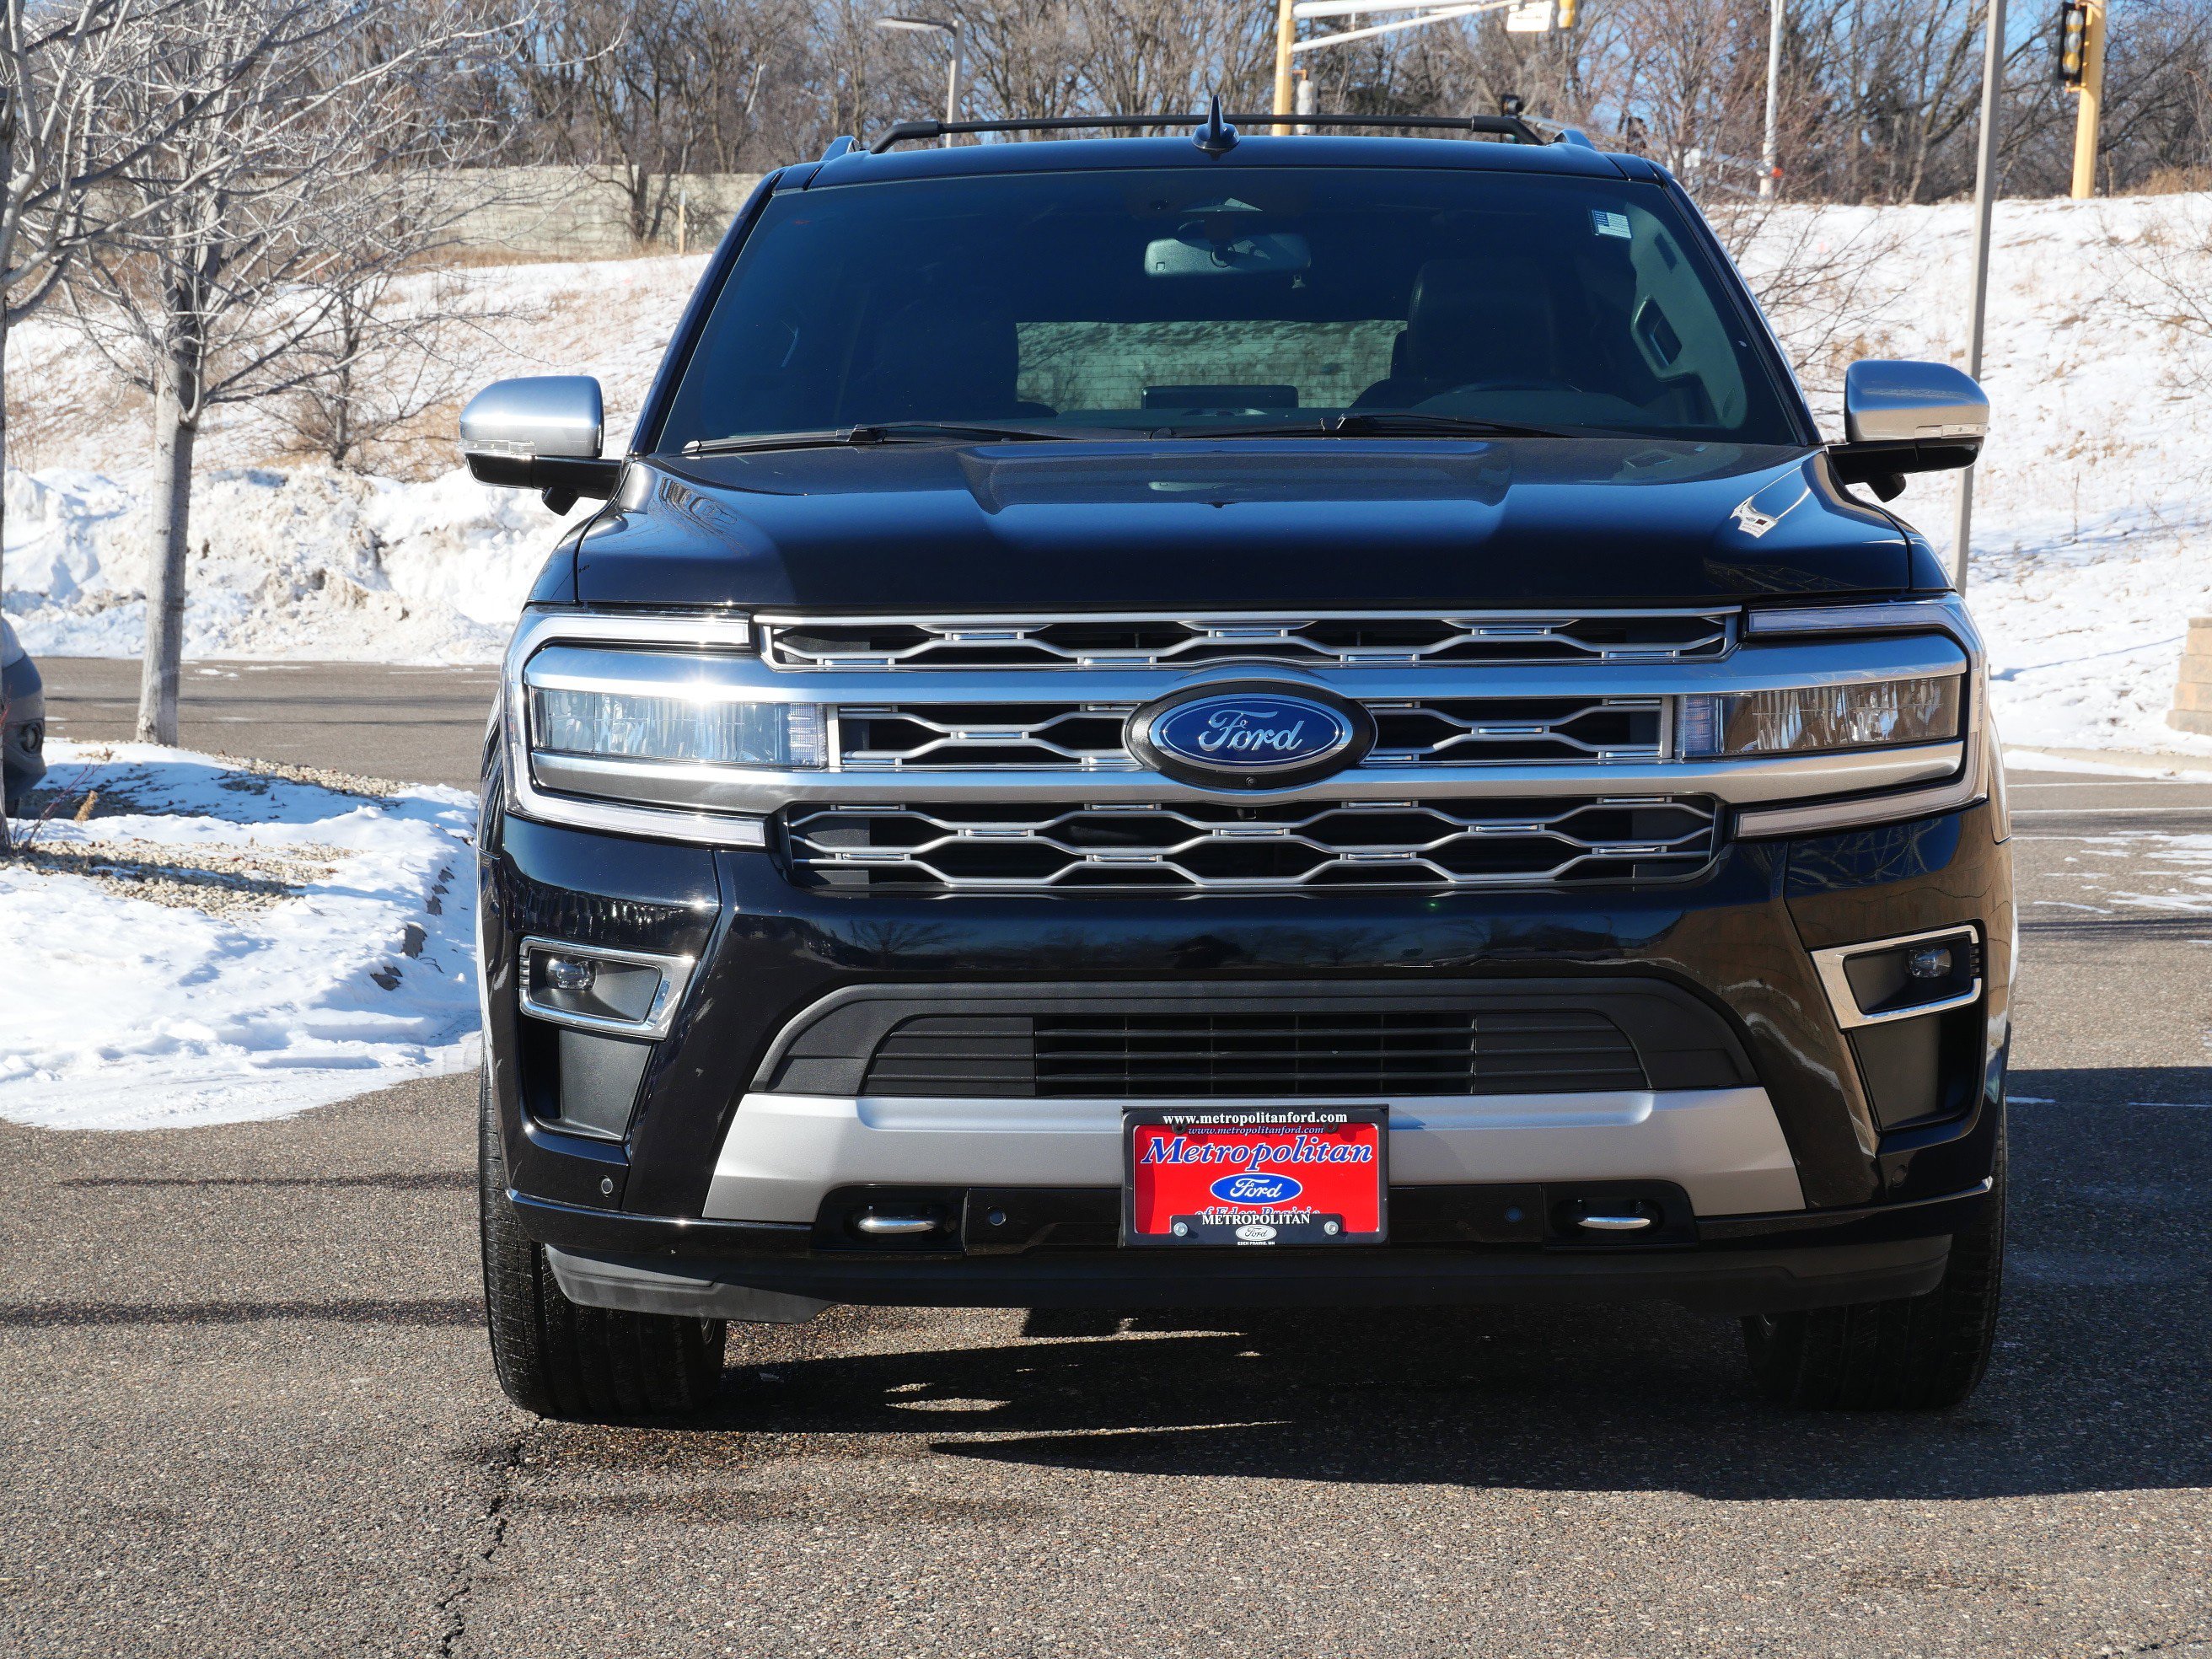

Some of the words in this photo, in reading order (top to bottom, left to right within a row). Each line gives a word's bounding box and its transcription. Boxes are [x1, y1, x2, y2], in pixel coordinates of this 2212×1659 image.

[1198, 709, 1305, 751] Ford
[1162, 1112, 1348, 1126] www.metropolitanford.com
[1188, 1125, 1324, 1136] www.metropolitanford.com
[1141, 1135, 1372, 1172] Metropolitan
[1229, 1178, 1282, 1198] Ford
[1202, 1214, 1310, 1225] METROPOLITAN
[1244, 1227, 1268, 1237] Ford
